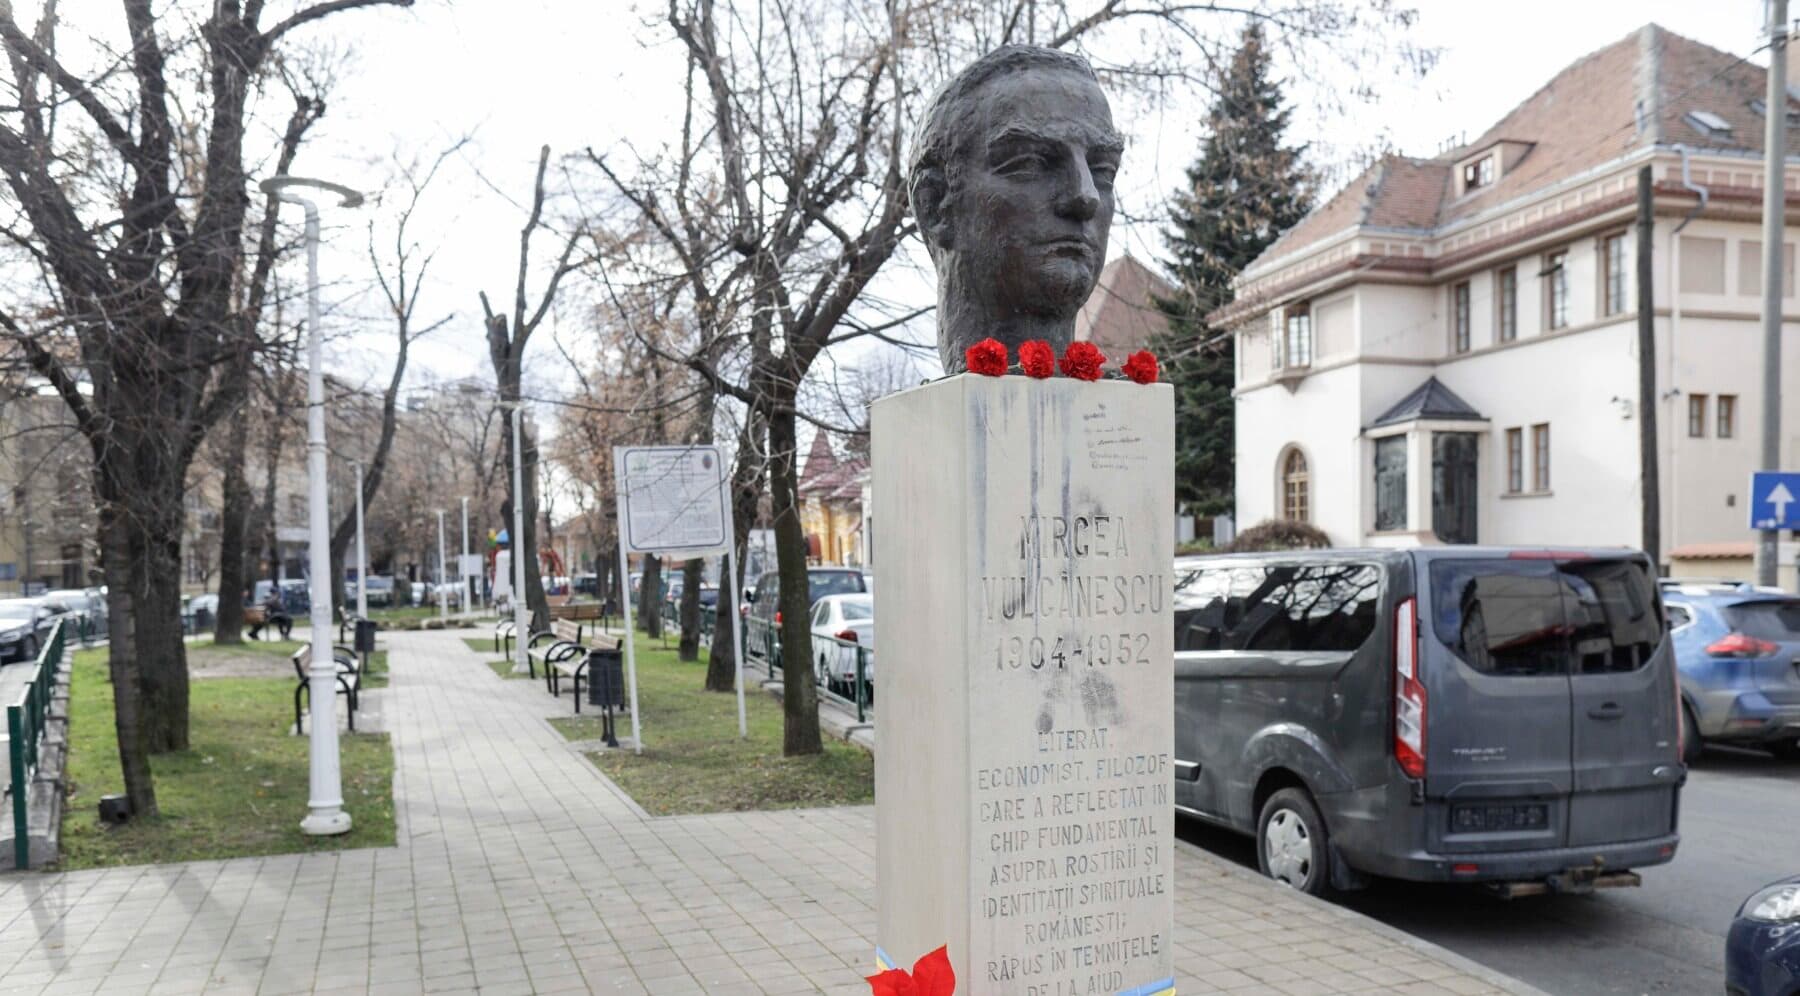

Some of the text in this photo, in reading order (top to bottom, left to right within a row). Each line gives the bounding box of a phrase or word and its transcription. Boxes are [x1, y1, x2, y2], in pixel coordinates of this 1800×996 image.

[1019, 515, 1128, 560] MIRCEA
[1096, 753, 1168, 780] FILOZOF
[979, 797, 1026, 822] CARE
[1034, 796, 1044, 818] A
[1052, 785, 1145, 816] REFLECTAT
[990, 815, 1157, 853] CHIP FUNDAMENTAL
[990, 857, 1058, 886] ASUPRA
[1079, 873, 1164, 906] SPIRITUALE
[987, 954, 1044, 982] RĂPUS
[1087, 970, 1123, 996] AIUD
